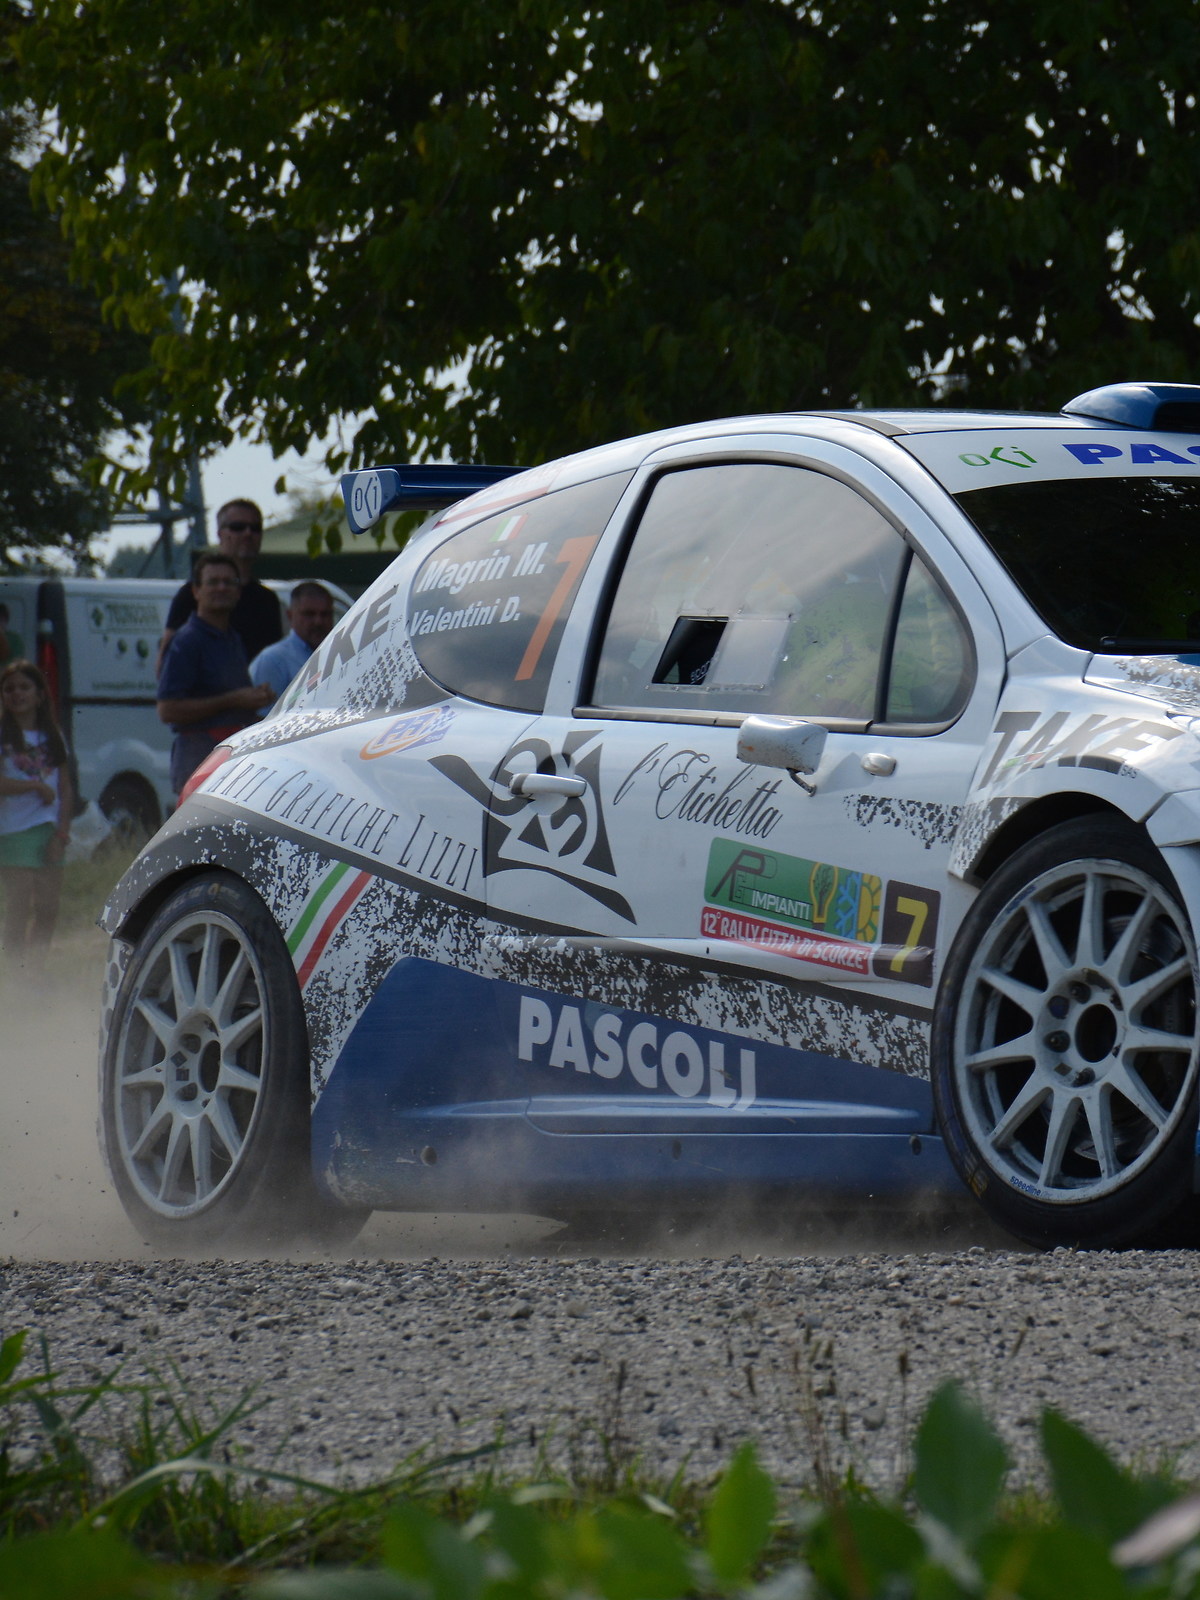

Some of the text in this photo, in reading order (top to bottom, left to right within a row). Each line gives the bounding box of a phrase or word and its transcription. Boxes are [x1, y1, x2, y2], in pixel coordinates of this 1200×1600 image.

[416, 542, 548, 595] Magrin M.
[409, 596, 521, 637] Valentini D.
[978, 711, 1186, 790] TAKE
[206, 756, 478, 892] ARTI GRAFICHE LIZZI
[720, 917, 759, 944] RALLY
[796, 937, 814, 955] DI
[751, 890, 810, 920] IMPIANTI
[889, 896, 929, 973] 7
[518, 996, 757, 1113] PASCOLI
